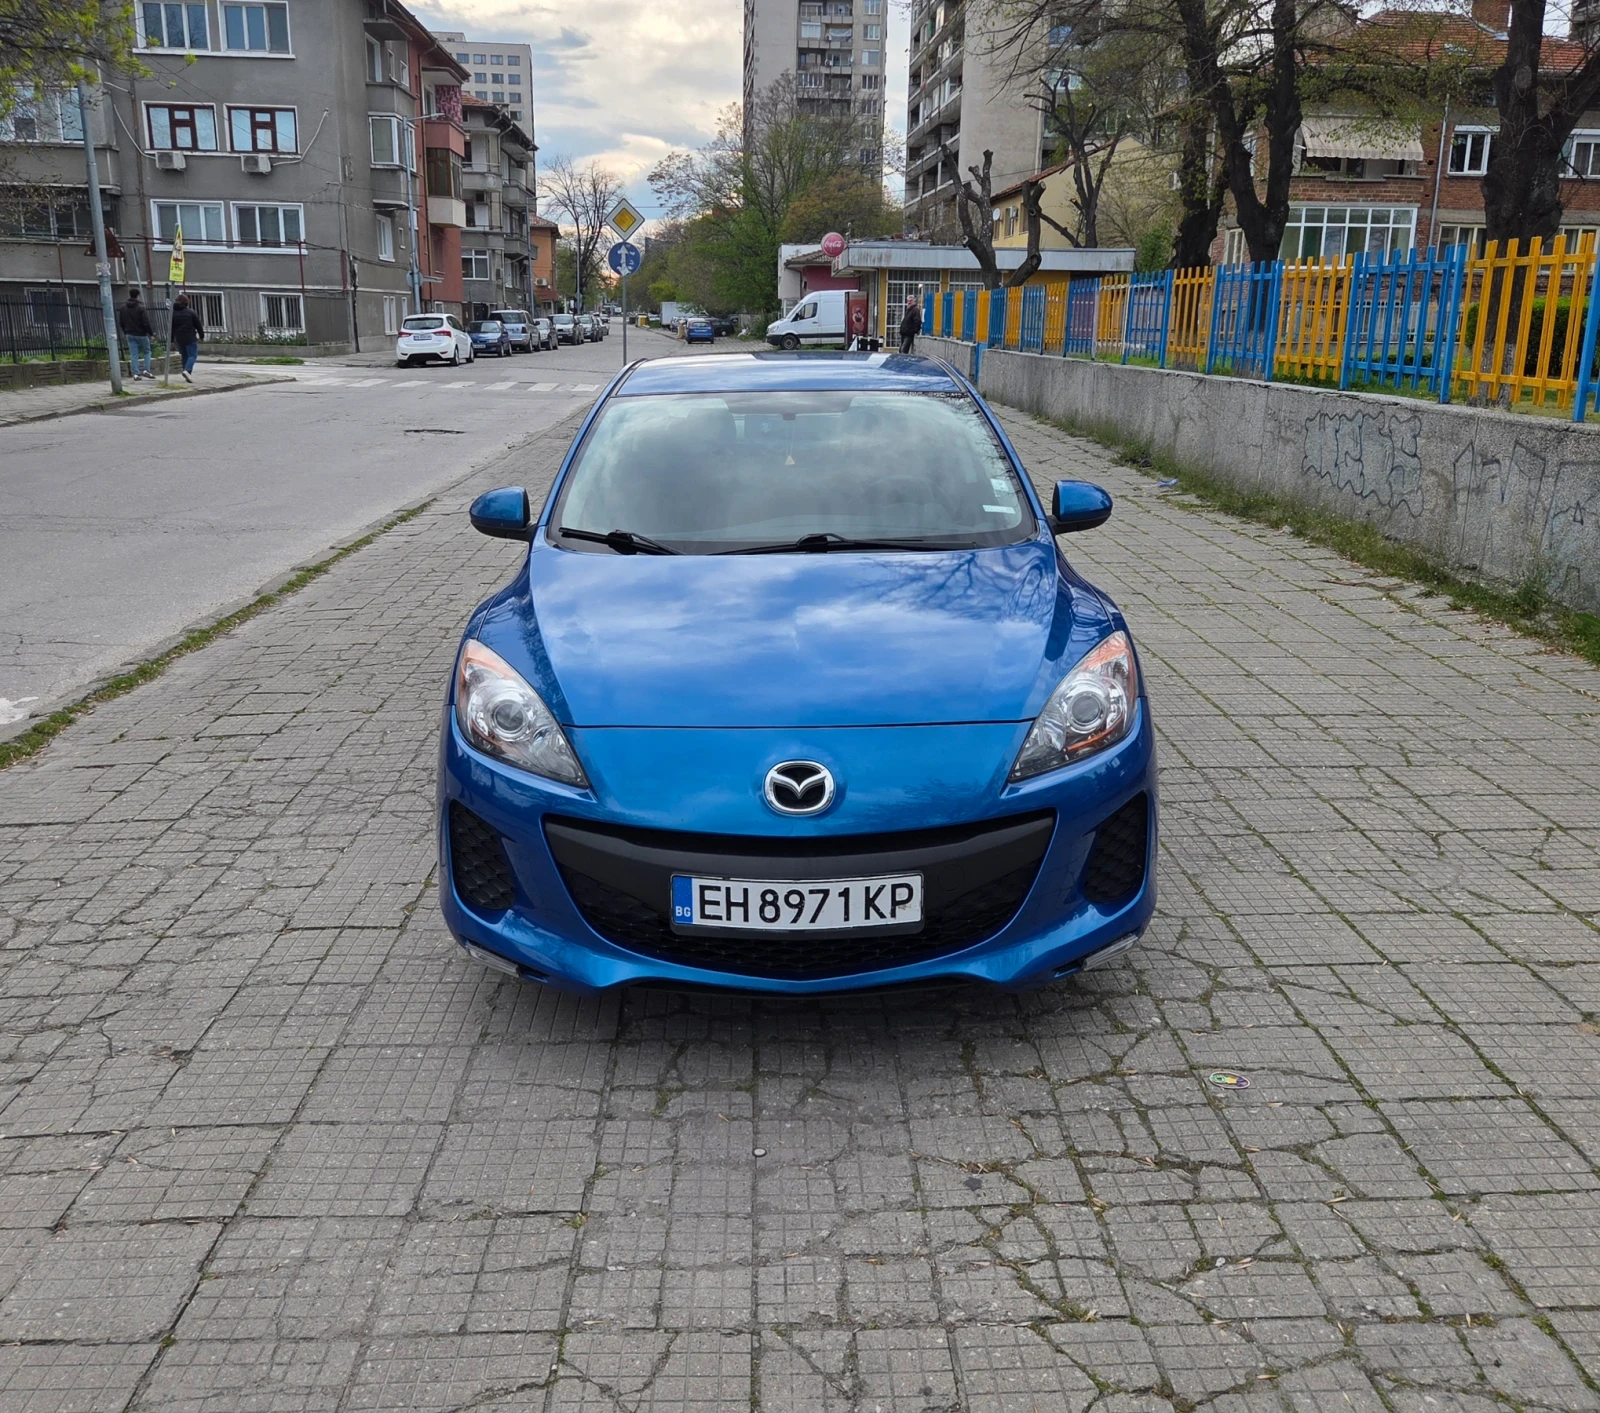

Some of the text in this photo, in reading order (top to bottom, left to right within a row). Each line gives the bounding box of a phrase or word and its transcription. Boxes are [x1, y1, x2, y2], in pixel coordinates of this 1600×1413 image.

[675, 905, 692, 917] BG
[699, 883, 914, 924] EH 8971 KP
